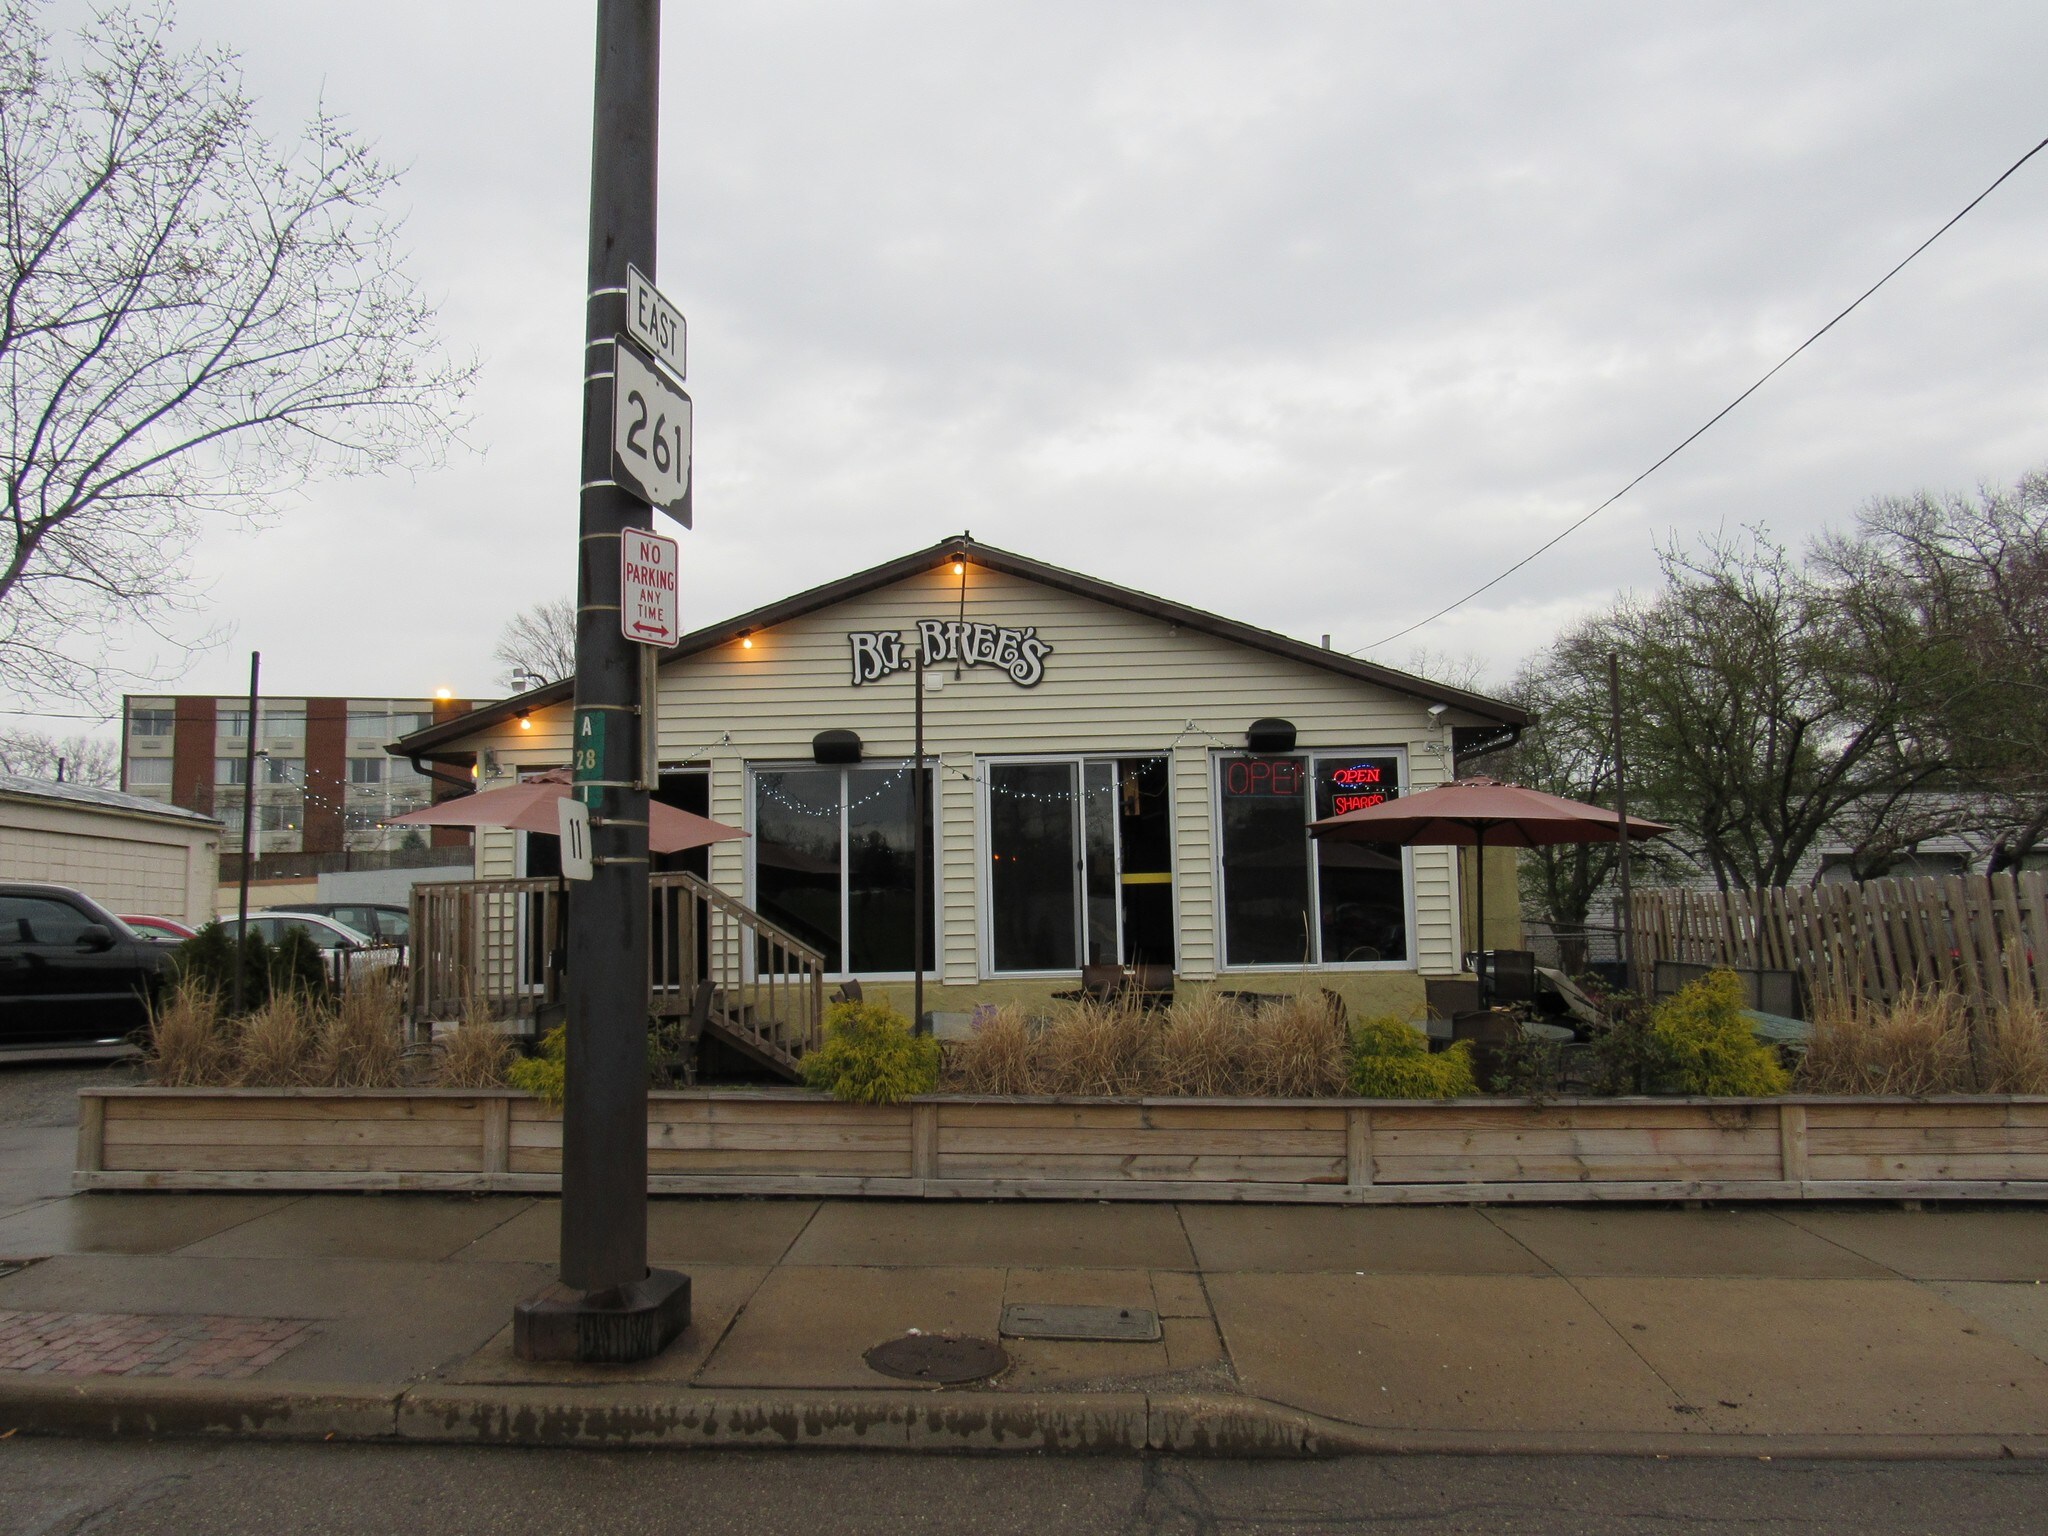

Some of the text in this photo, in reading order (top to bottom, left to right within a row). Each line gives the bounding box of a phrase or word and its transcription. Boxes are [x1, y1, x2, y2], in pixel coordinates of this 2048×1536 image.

[638, 285, 677, 357] EAST
[626, 389, 681, 485] 261
[640, 541, 661, 565] NO
[626, 562, 675, 592] PARKING
[640, 588, 661, 605] ANY
[637, 603, 664, 622] TIME
[848, 619, 1053, 688] B.G. BREE'S
[582, 715, 592, 737] A
[575, 748, 596, 771] 28
[1333, 768, 1381, 784] OPEN
[569, 817, 583, 860] 11
